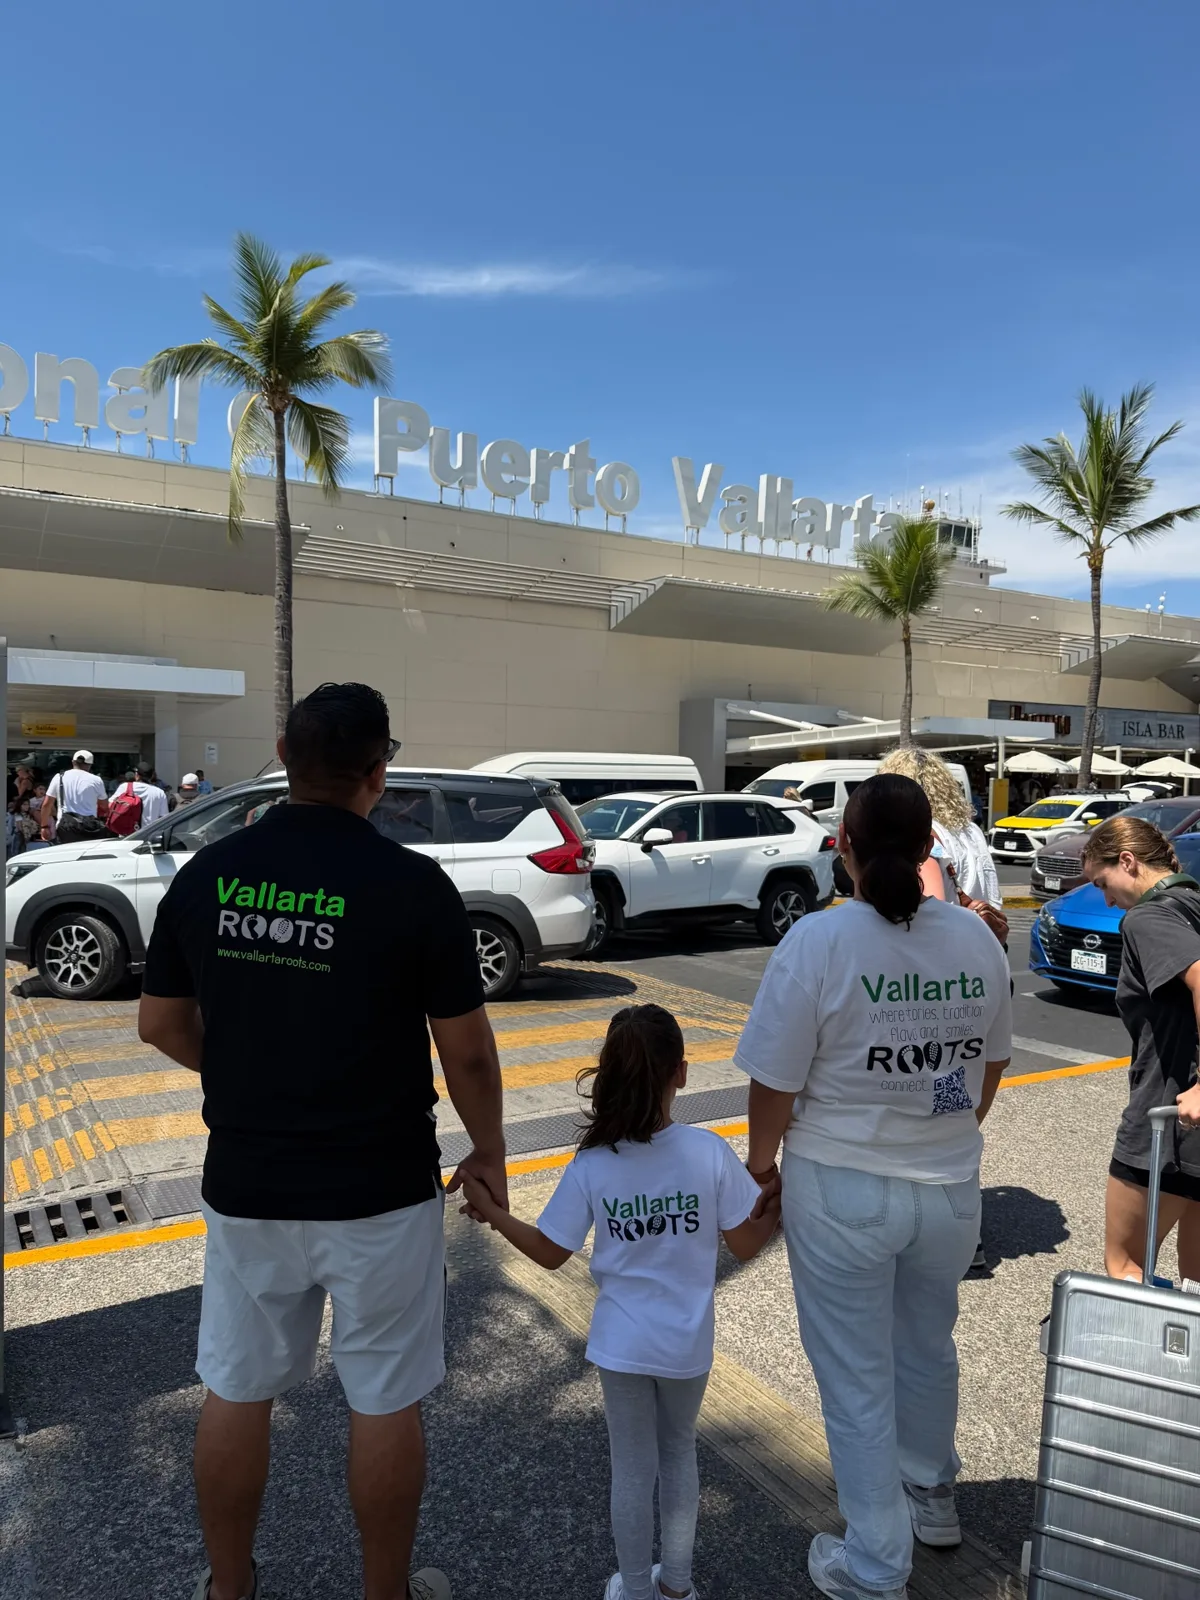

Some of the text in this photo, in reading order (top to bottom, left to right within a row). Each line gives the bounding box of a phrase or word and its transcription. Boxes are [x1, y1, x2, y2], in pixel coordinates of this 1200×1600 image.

[374, 396, 640, 516] Puerto
[672, 456, 907, 555] Vallarta
[1122, 721, 1185, 739] ISLA BAR
[217, 876, 345, 917] Vallarta
[217, 909, 335, 950] ROOTS
[217, 947, 331, 973] www.vallartaroots.com
[861, 971, 986, 1003] Vallarta
[868, 1008, 905, 1024] where
[920, 1025, 939, 1039] and
[866, 1037, 984, 1074] ROOTS
[602, 1190, 699, 1219] Vallarta
[606, 1210, 700, 1242] ROOTS
